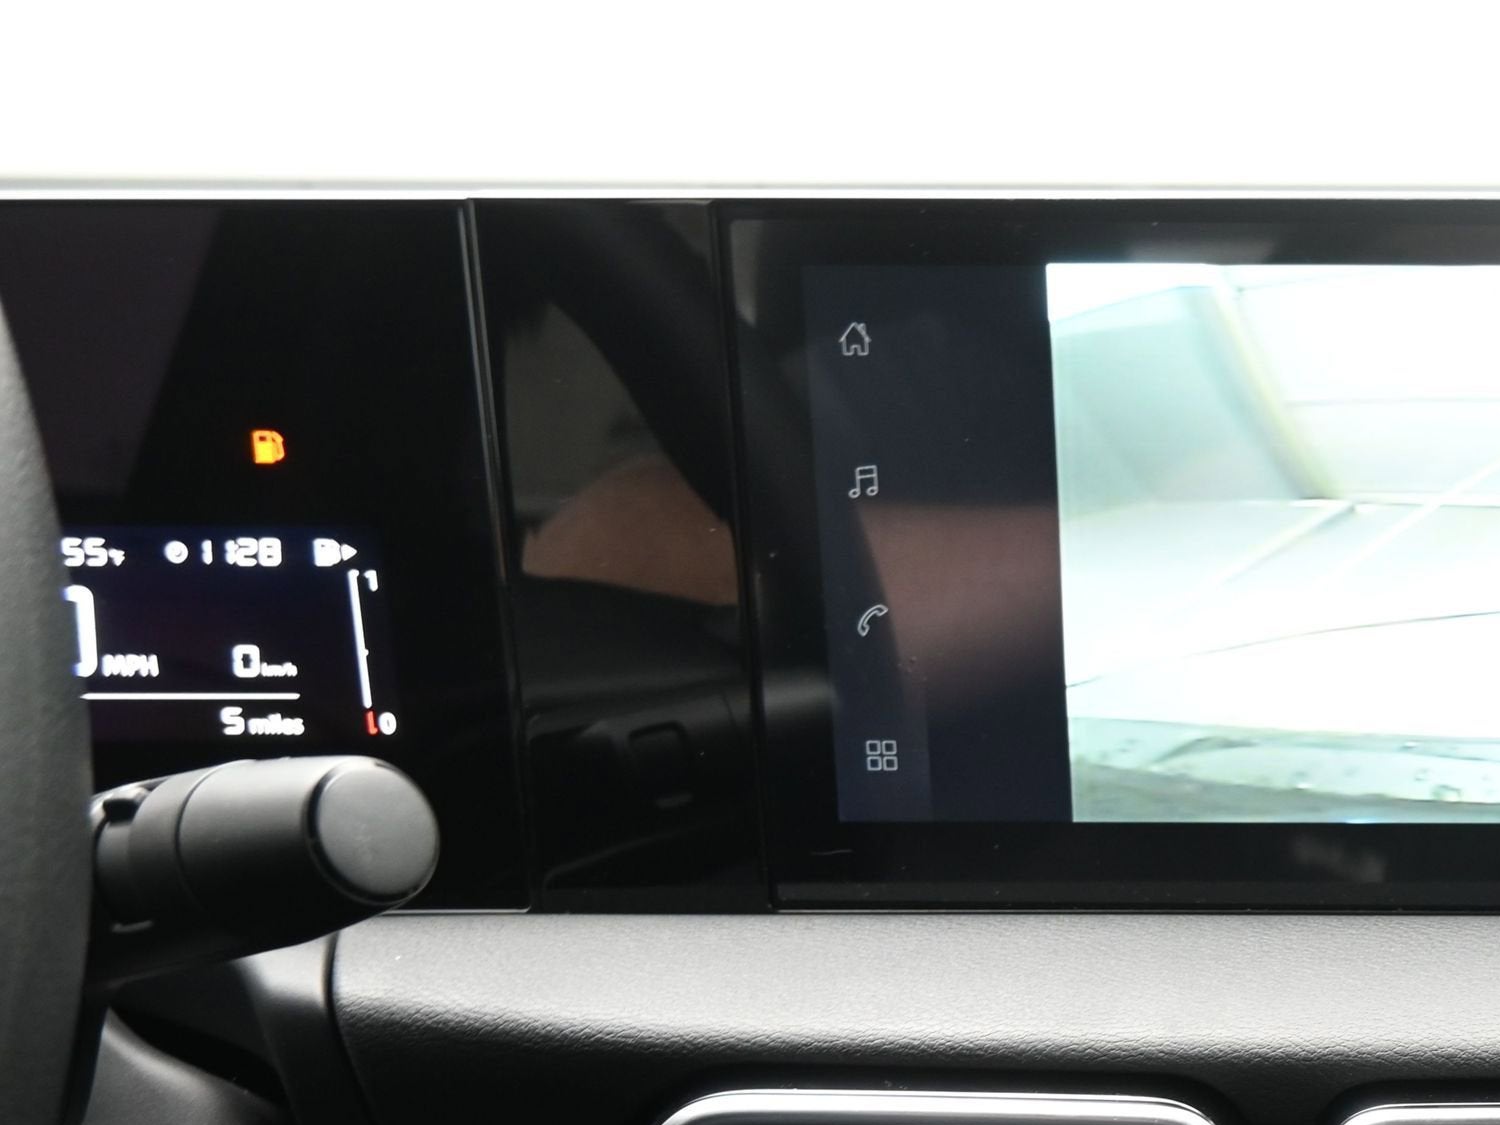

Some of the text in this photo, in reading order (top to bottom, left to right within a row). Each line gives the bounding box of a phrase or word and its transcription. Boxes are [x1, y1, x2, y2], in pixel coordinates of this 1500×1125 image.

[201, 537, 282, 567] 11:28
[363, 569, 378, 592] 1
[102, 653, 159, 677] MPH
[220, 706, 305, 735] 5 miles
[378, 711, 397, 735] 0
